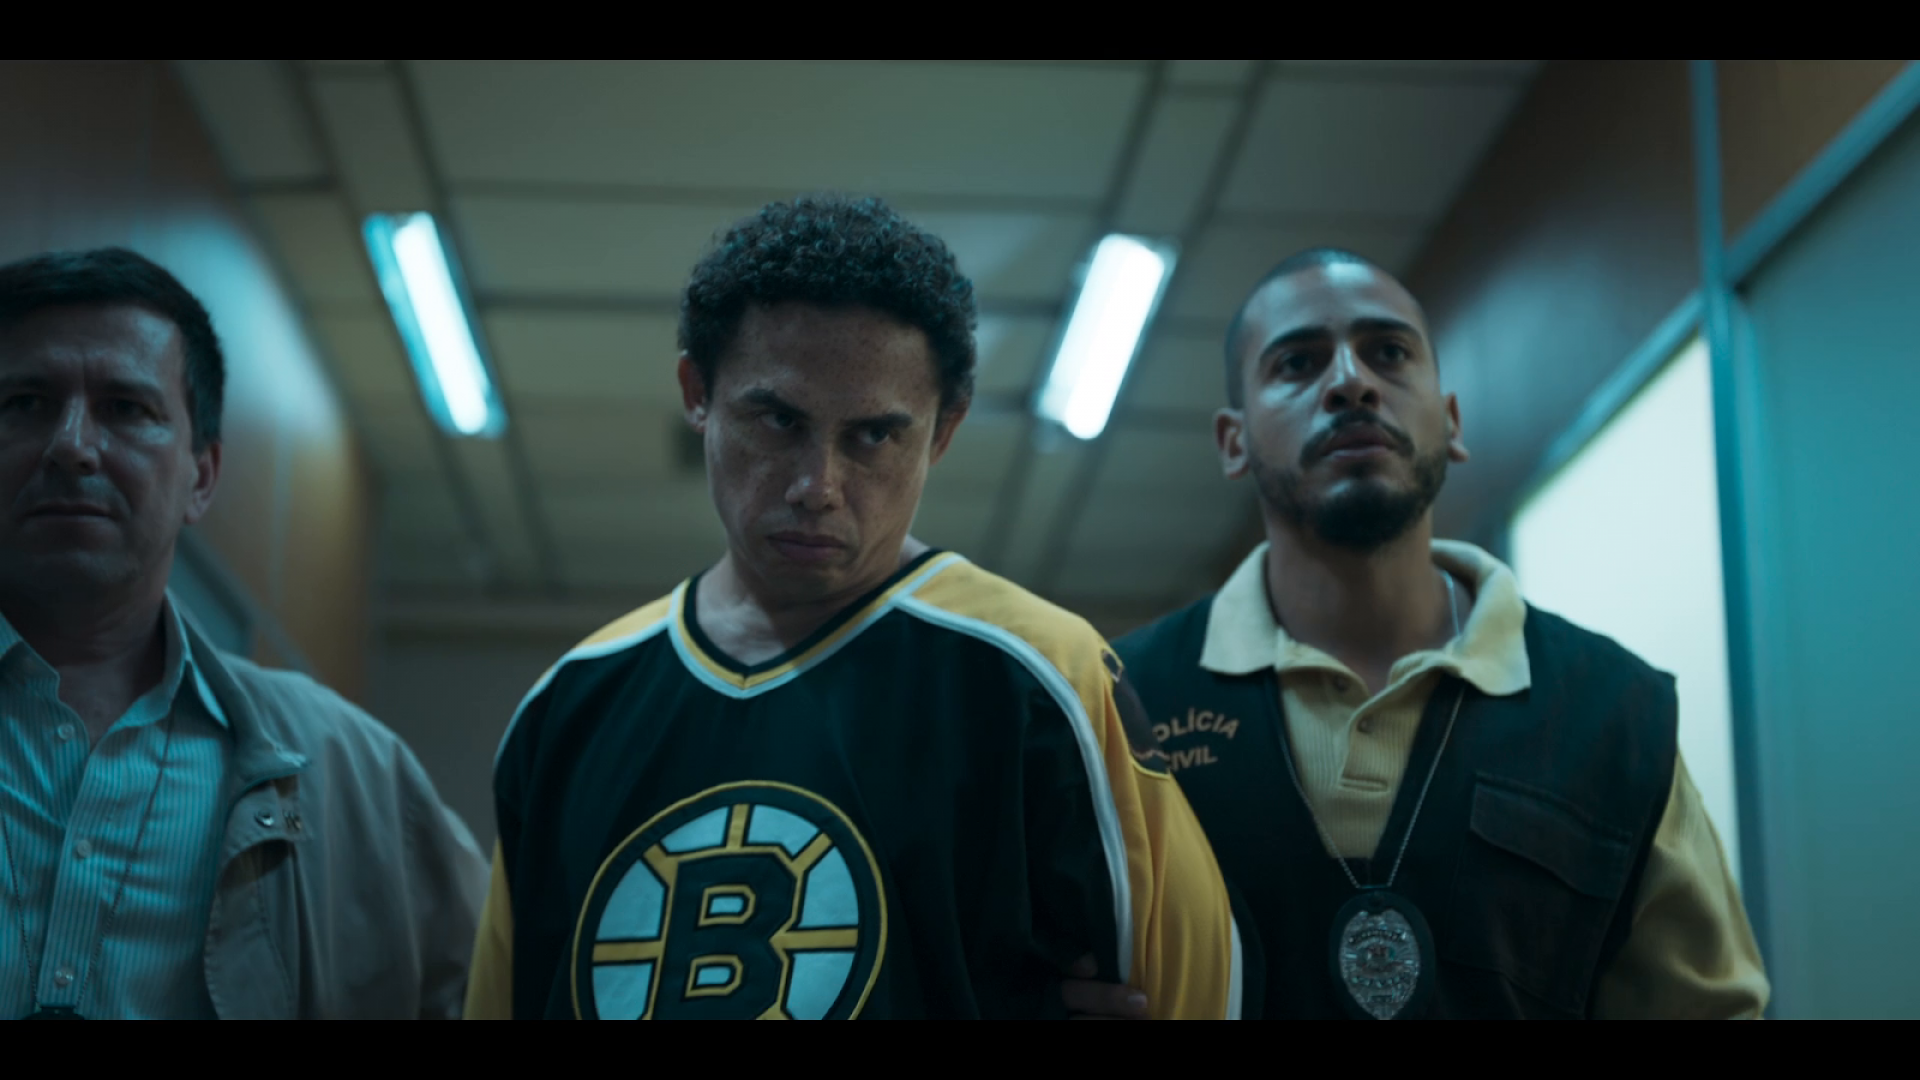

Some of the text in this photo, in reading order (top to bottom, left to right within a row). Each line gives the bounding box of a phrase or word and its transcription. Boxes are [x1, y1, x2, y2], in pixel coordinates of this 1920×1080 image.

[1152, 706, 1240, 743] OLÍCIA
[1168, 745, 1219, 772] IVIL
[649, 850, 799, 1020] B
